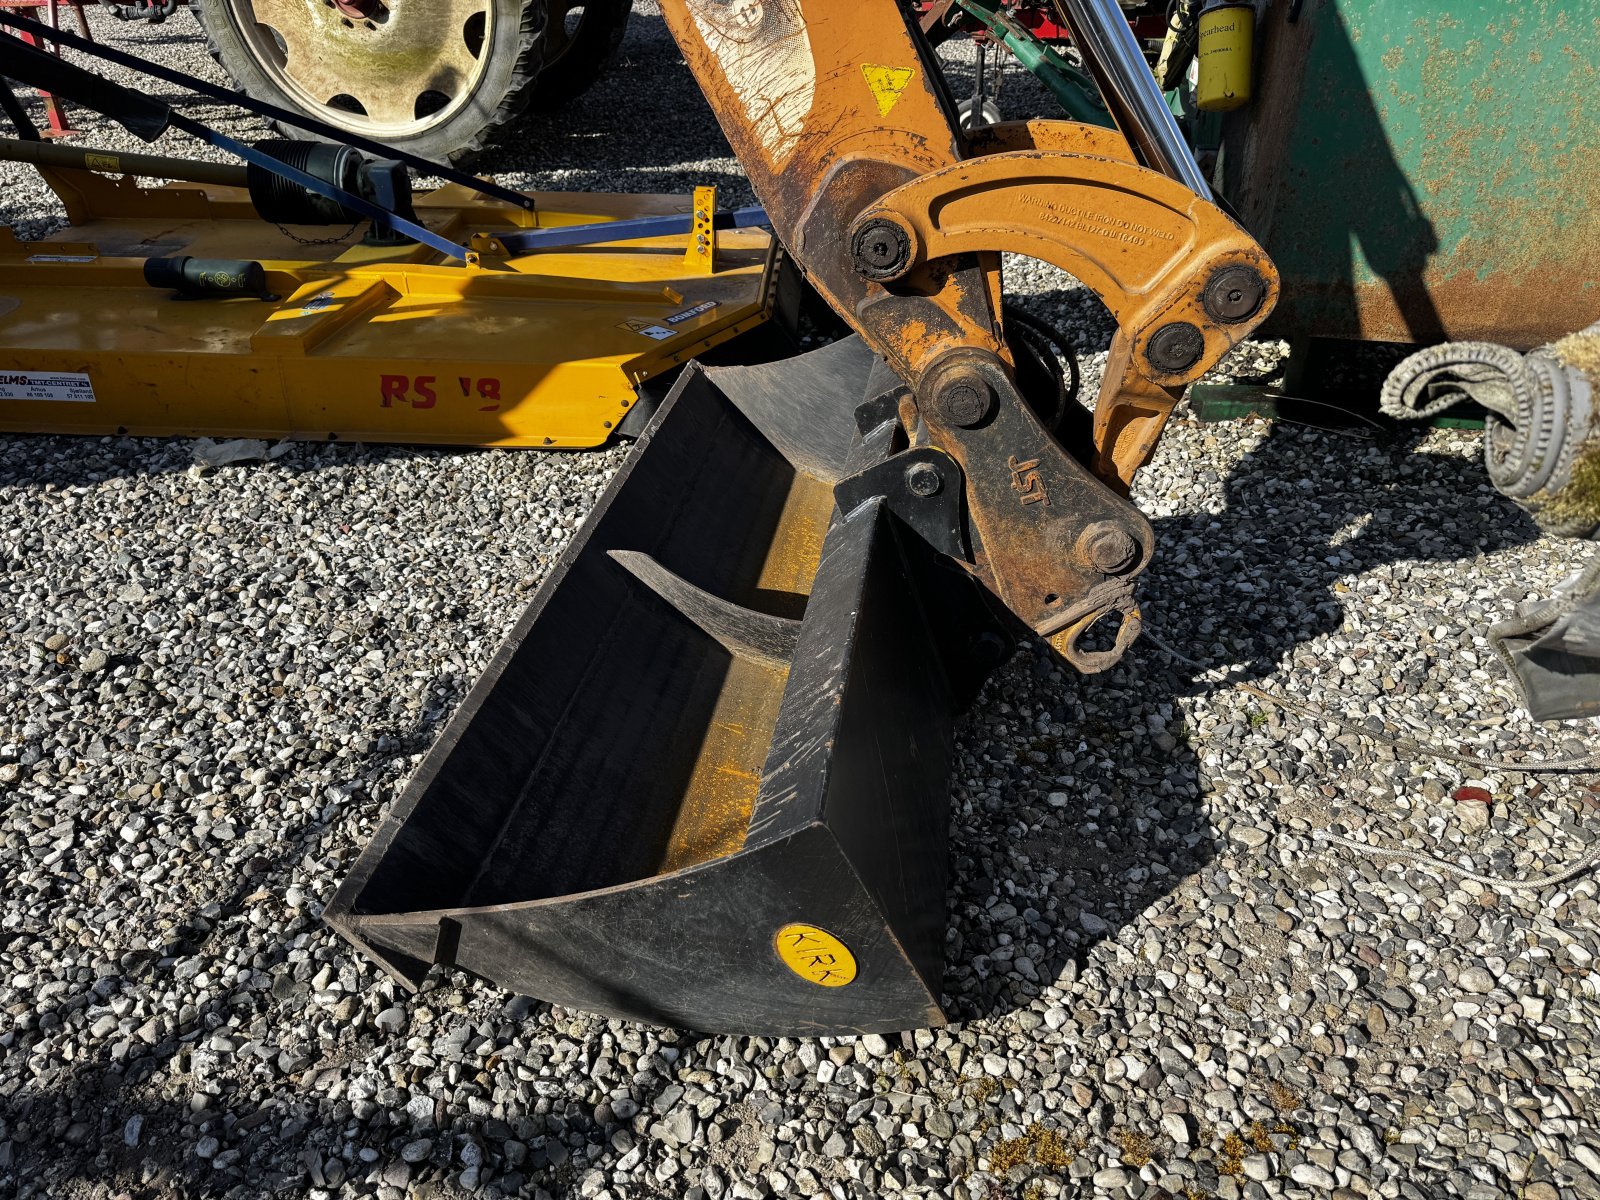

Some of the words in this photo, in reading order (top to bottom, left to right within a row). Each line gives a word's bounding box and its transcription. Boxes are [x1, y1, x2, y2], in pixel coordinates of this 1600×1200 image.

[1200, 22, 1235, 40] pearhead
[1018, 192, 1057, 211] WARNING
[1058, 203, 1094, 220] DUCTILE
[1094, 211, 1116, 226] IRON
[1131, 222, 1149, 235] NOT
[1149, 228, 1174, 241] WELD
[666, 301, 718, 324] BOMFORD
[380, 375, 437, 410] RS
[784, 931, 849, 982] KIRK
